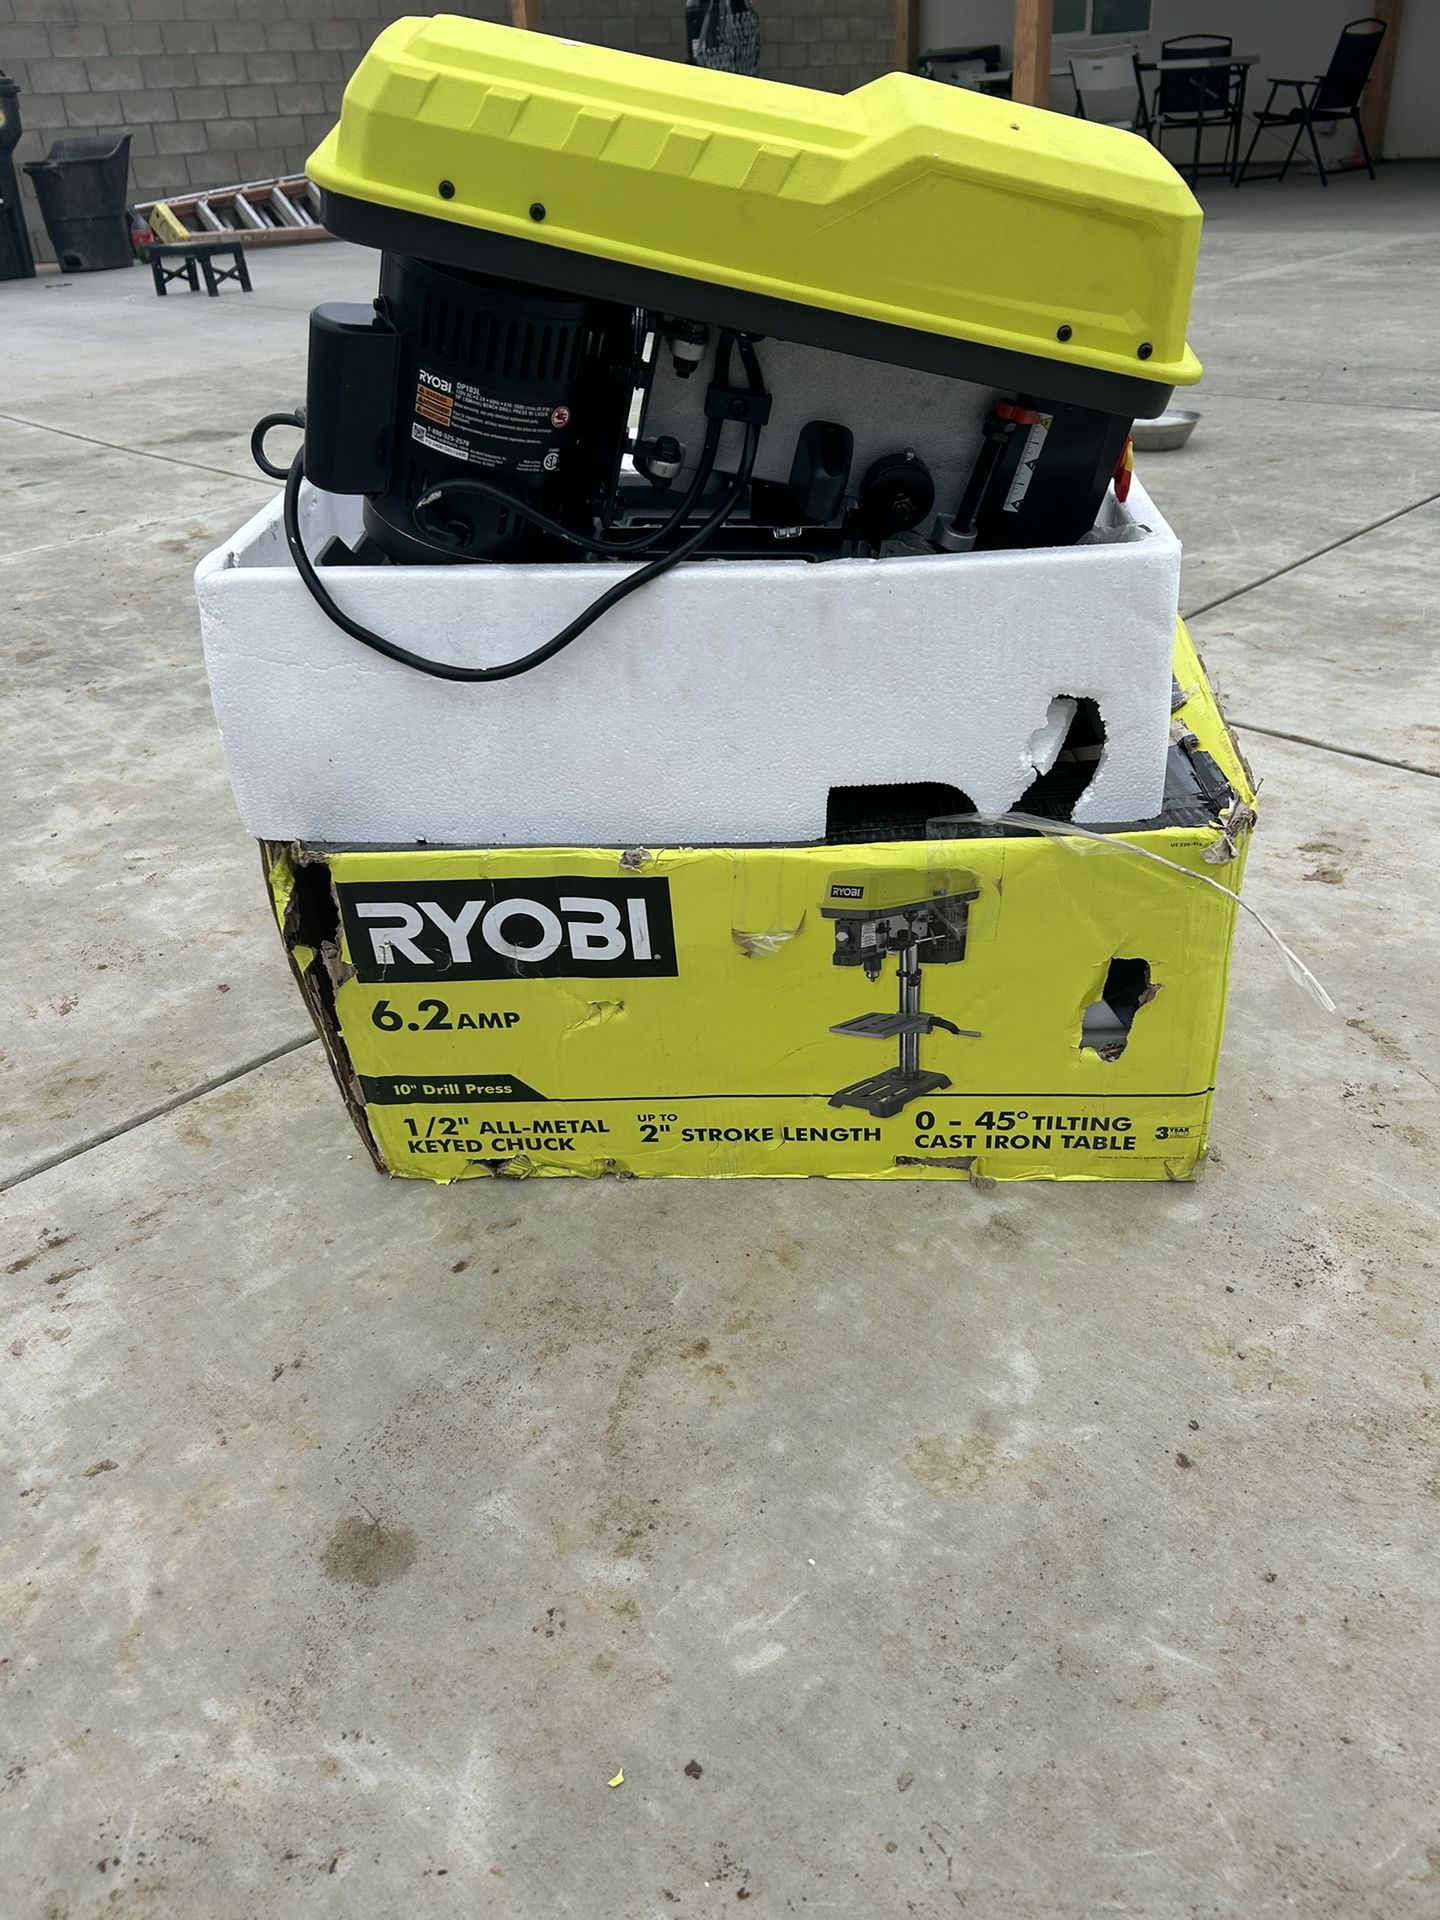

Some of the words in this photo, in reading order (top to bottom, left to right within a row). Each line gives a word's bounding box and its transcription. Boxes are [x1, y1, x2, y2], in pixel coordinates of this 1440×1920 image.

[419, 369, 452, 393] RYOBI
[832, 887, 861, 897] RYOBI
[355, 896, 653, 965] RYOBI
[371, 999, 453, 1032] 6.2
[457, 1012, 521, 1030] AMP
[392, 1084, 417, 1096] 10"
[423, 1083, 460, 1096] Drill
[466, 1083, 513, 1096] Press
[403, 1116, 470, 1137] 1/2"
[480, 1119, 610, 1135] ALL-METAL
[637, 1114, 656, 1122] UP
[660, 1113, 678, 1122] TO
[915, 1110, 935, 1131] 0
[975, 1110, 1029, 1131] 45°
[1032, 1115, 1133, 1132] TILTING
[639, 1124, 670, 1143] 2"
[681, 1127, 774, 1143] STROKE
[783, 1127, 882, 1143] LENGTH
[1154, 1126, 1169, 1140] 3
[407, 1138, 483, 1154] KEYED
[491, 1137, 576, 1152] CHUCK
[914, 1134, 976, 1150] CAST
[985, 1134, 1051, 1150] IRON
[1060, 1134, 1137, 1151] TABLE
